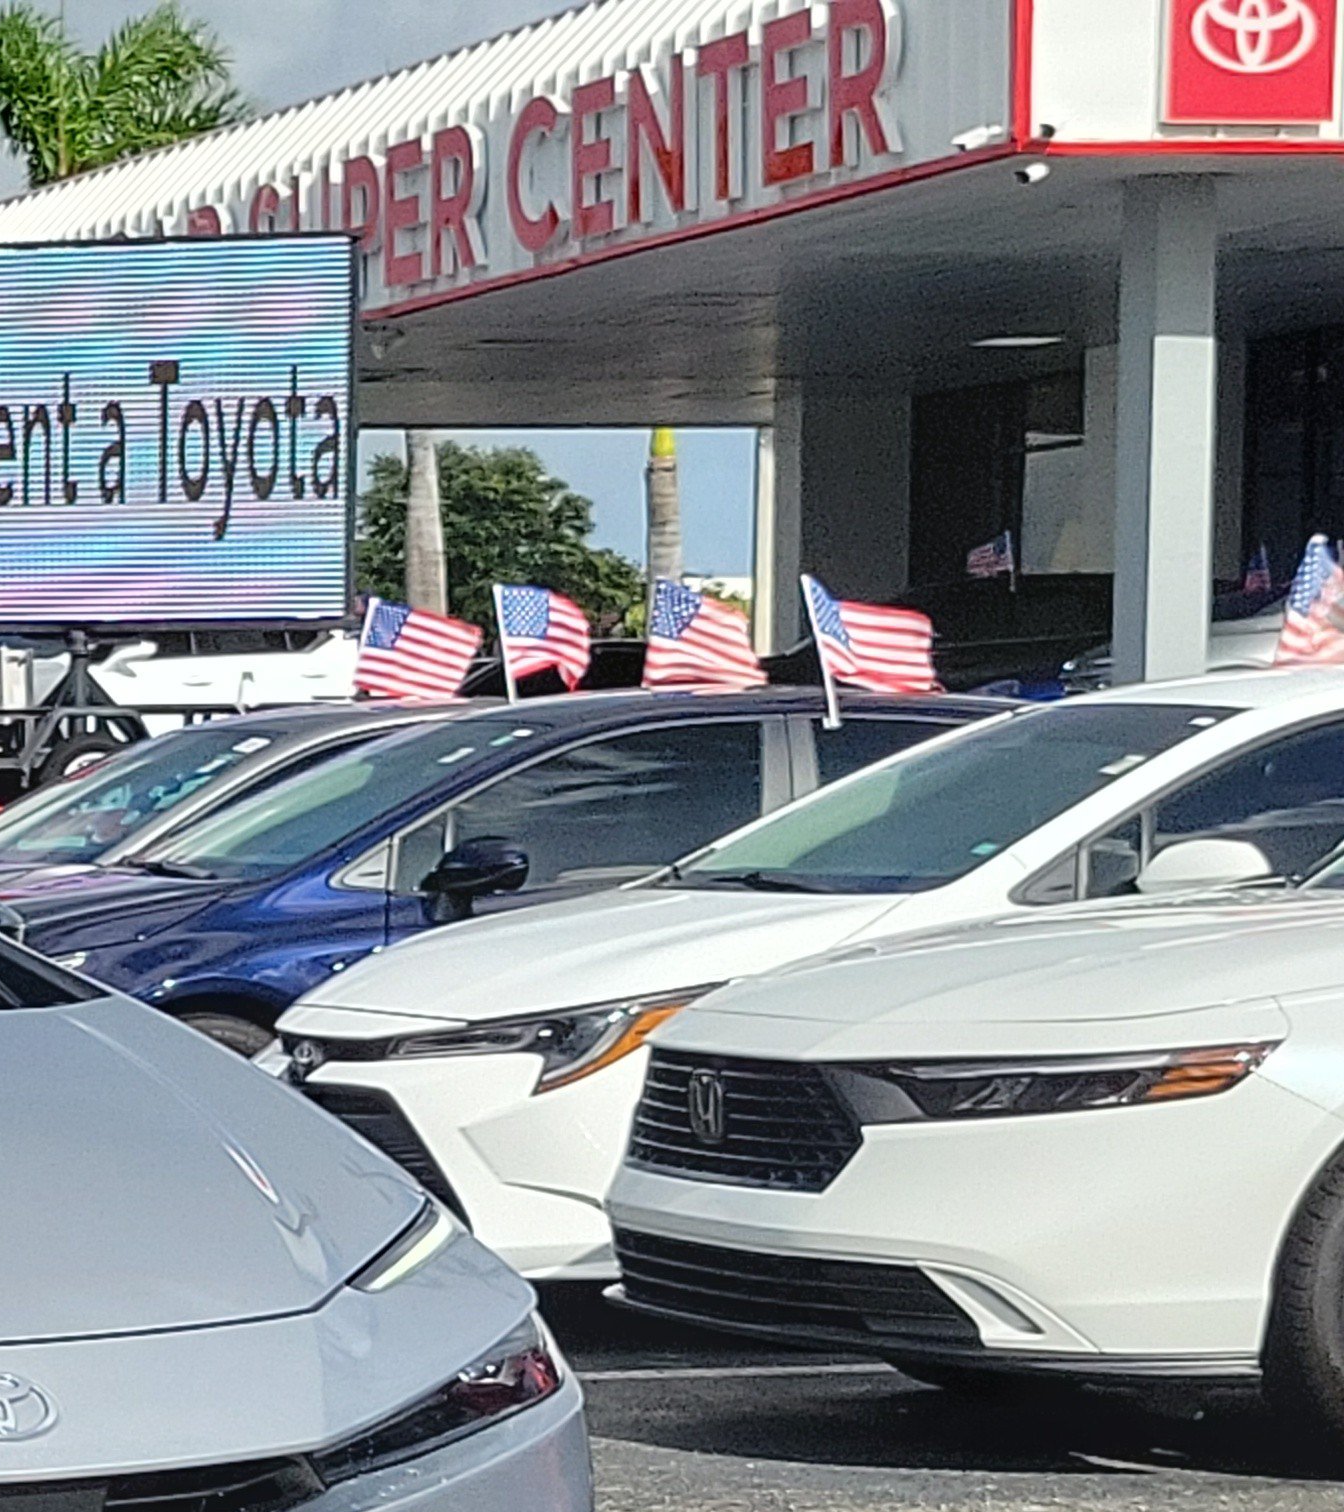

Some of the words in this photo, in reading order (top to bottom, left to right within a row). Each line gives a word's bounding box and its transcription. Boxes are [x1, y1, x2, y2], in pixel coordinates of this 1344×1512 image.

[506, 0, 894, 253] CENTER
[99, 400, 126, 505] a
[149, 359, 340, 540] Toyota
